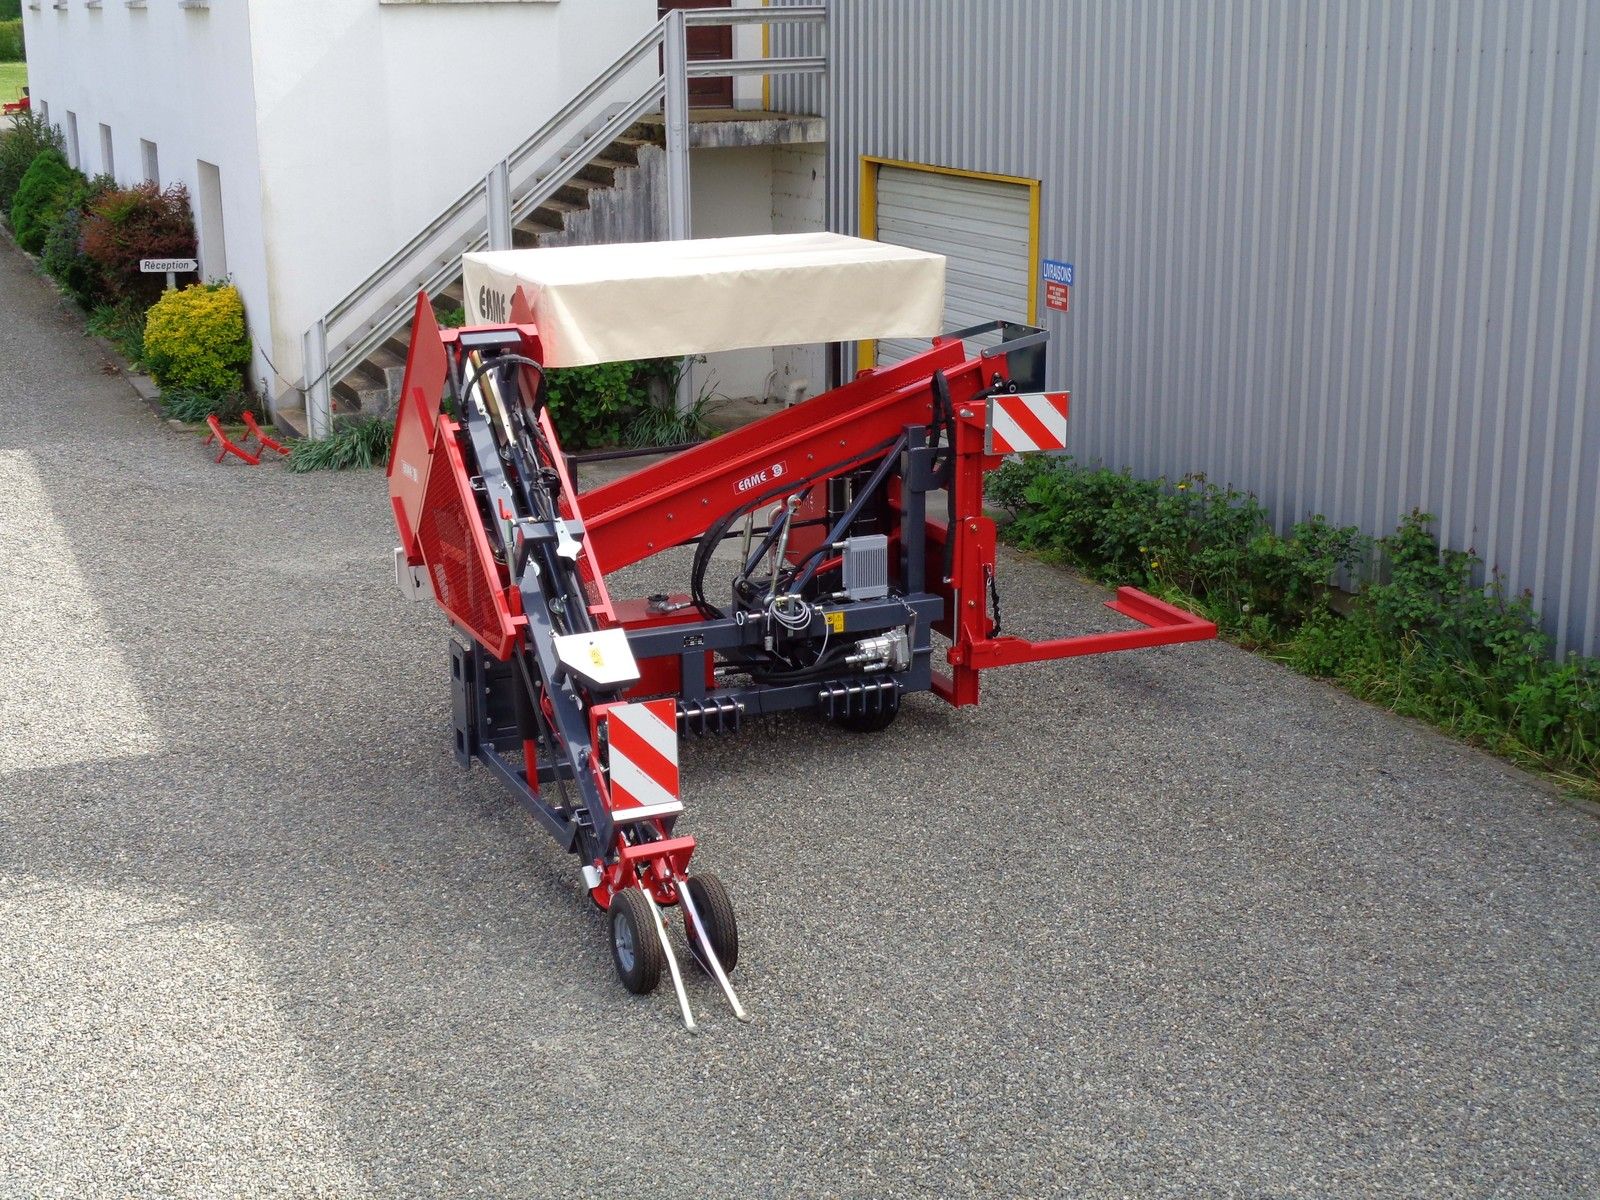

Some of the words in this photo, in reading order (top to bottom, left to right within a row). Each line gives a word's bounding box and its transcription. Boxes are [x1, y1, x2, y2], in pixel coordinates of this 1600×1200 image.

[144, 261, 189, 271] Réception
[1043, 262, 1072, 283] LIVRAISONS
[479, 285, 505, 324] ERME
[738, 471, 767, 491] ERME
